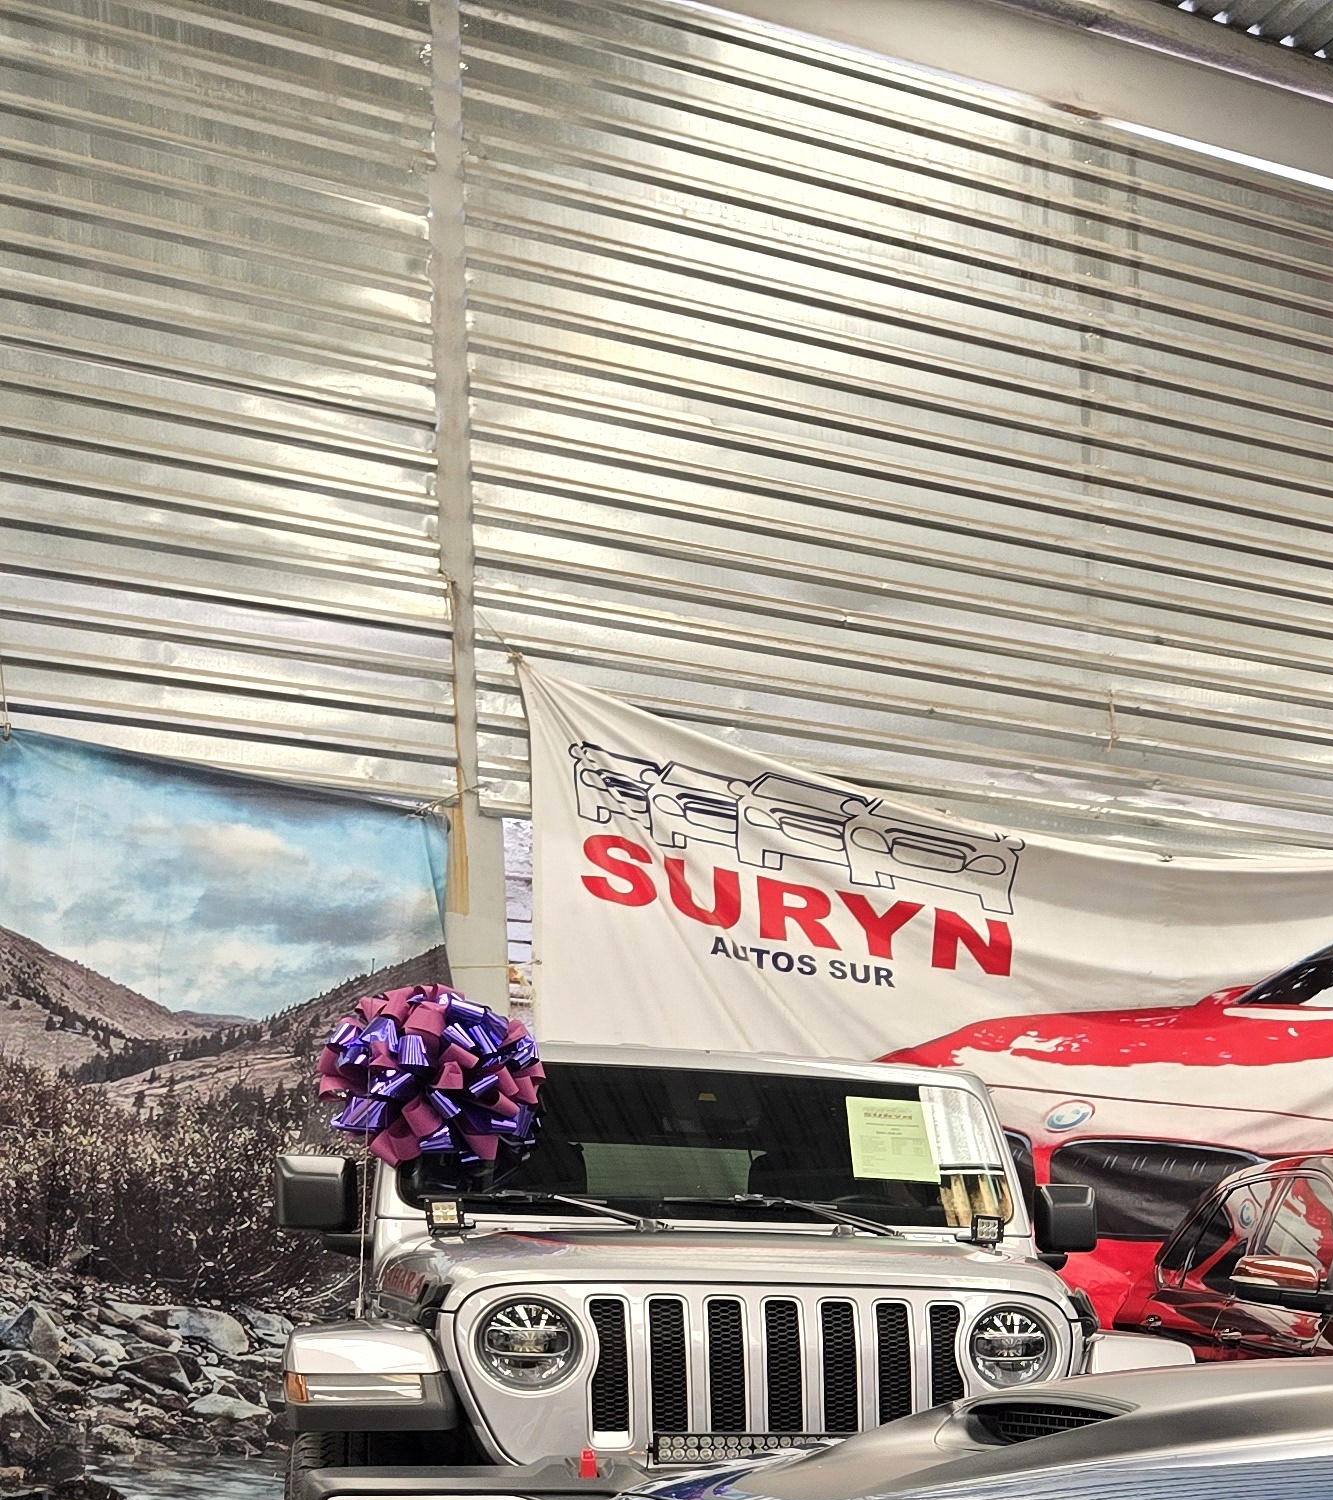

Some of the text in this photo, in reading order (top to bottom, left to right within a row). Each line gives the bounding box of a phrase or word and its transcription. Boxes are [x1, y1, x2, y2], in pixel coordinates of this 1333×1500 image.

[580, 834, 1013, 977] SURYN
[710, 936, 896, 989] AUTOS SUR
